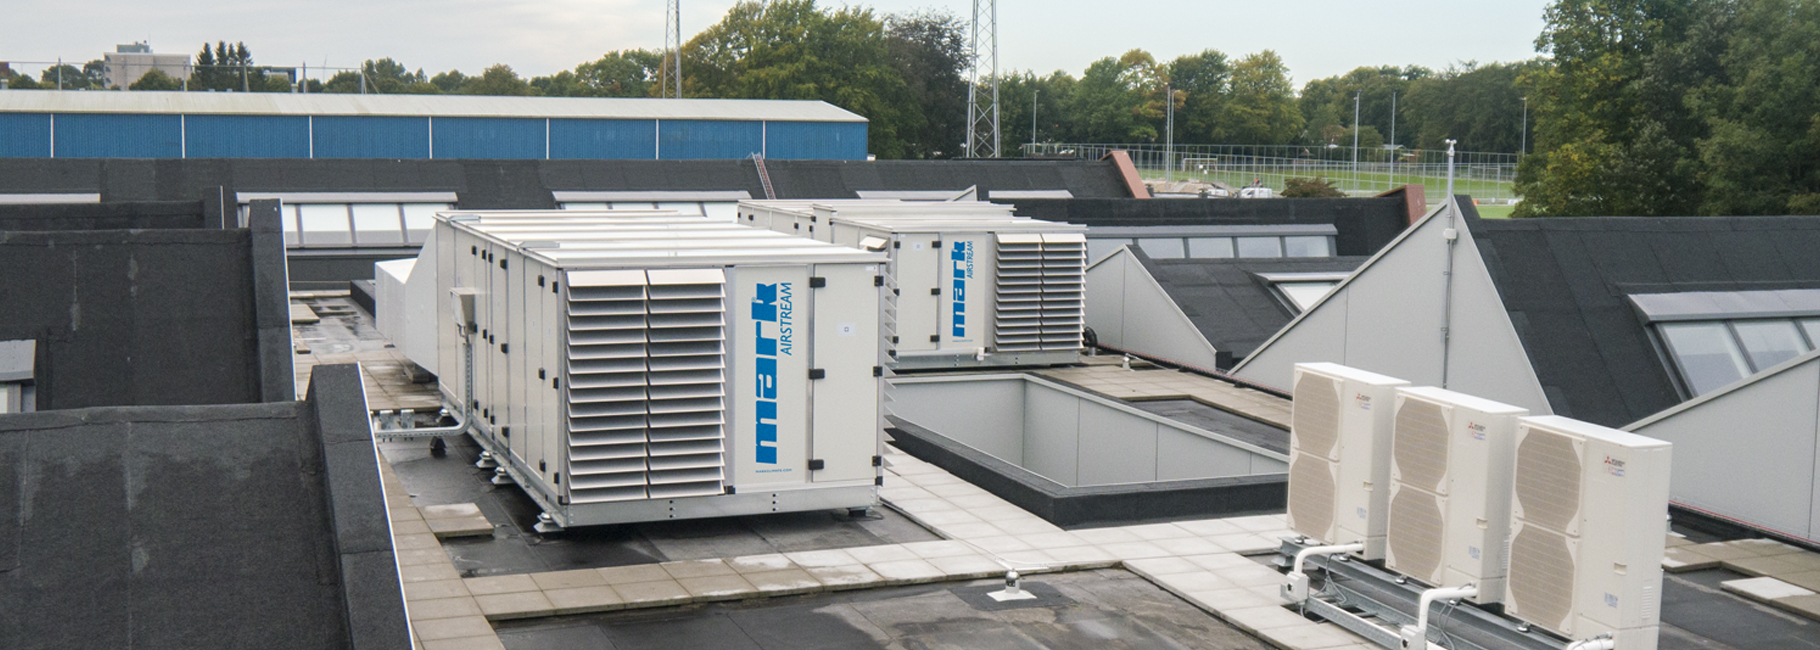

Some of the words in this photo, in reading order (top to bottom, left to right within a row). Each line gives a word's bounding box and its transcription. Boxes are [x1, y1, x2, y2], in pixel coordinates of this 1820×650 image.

[951, 241, 965, 337] mark
[966, 240, 974, 279] AIRSTREAM
[780, 282, 793, 356] AIRSTREAM
[751, 282, 777, 464] mark
